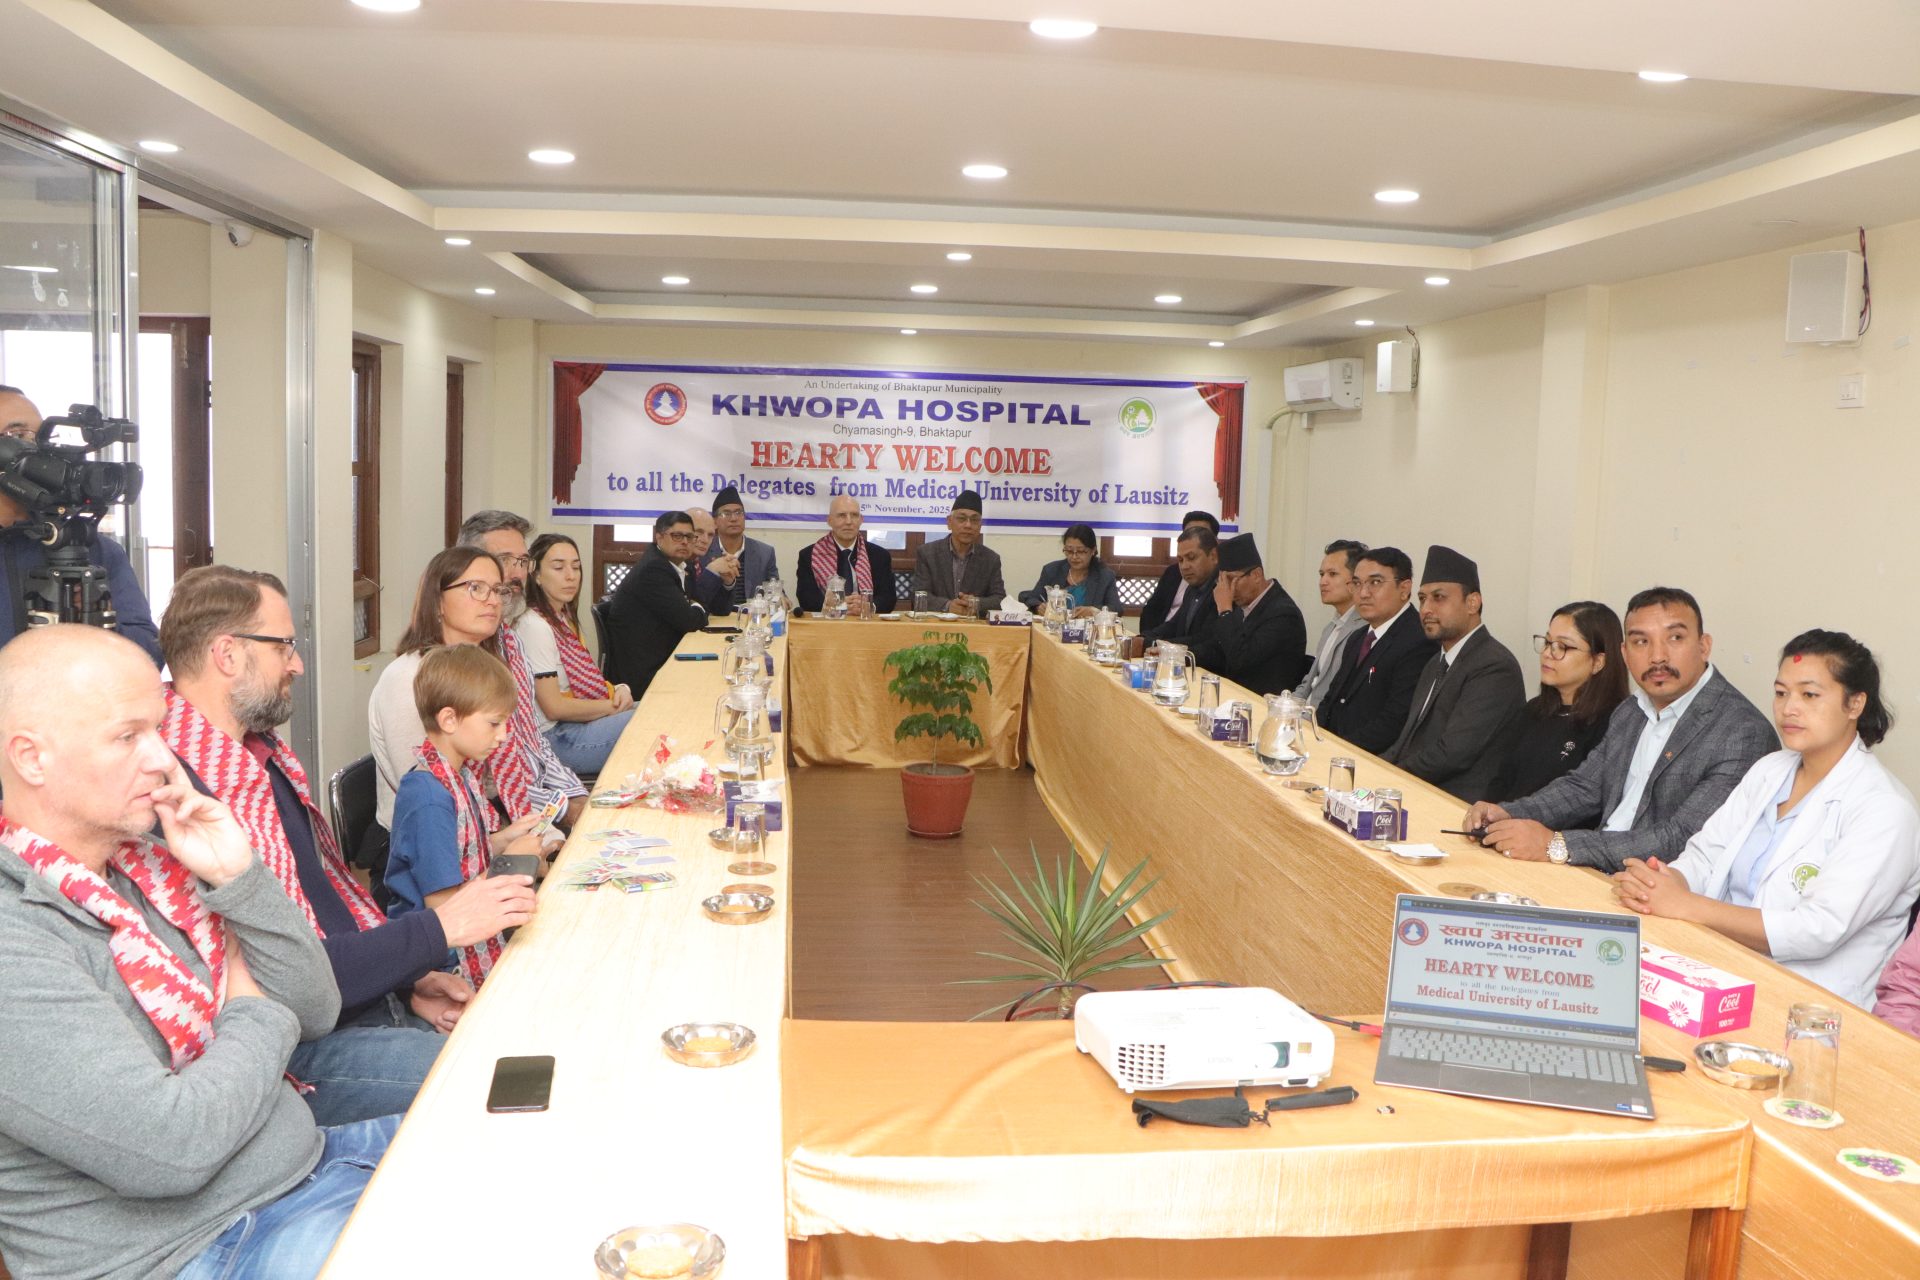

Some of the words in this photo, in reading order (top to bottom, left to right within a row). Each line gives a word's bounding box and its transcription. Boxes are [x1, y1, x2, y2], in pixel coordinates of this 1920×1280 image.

[804, 381, 818, 389] An
[820, 381, 879, 392] Undertaking
[881, 382, 892, 391] of
[894, 382, 942, 393] Bhaktapur
[945, 384, 1003, 396] Municipality
[712, 394, 884, 419] KHWOPA
[898, 399, 1091, 426] HOSPITAL
[833, 423, 916, 438] Chyamasingh-9,
[919, 426, 972, 438] Bhaktapur
[750, 441, 884, 470] HEARTY
[892, 445, 1052, 475] WELCOME
[607, 472, 629, 491] to
[636, 471, 663, 492] all
[671, 472, 704, 492] the
[711, 473, 816, 499] Delegates
[829, 476, 877, 497] from
[885, 478, 966, 499] Medical
[974, 480, 1081, 507] University
[1088, 483, 1109, 504] of
[1115, 484, 1189, 505] Lausitz
[874, 504, 926, 514] November,
[928, 505, 951, 514] 2025
[1439, 924, 1483, 938] ख्वप
[1490, 929, 1584, 948] अस्पताल
[1444, 938, 1503, 950] KHWOPA
[1508, 943, 1577, 958] HOSPITAL
[1424, 958, 1498, 978] HEARTY
[1503, 965, 1595, 988] WELCOME
[1416, 985, 1464, 1000] Medical
[1469, 990, 1533, 1010] University
[1536, 998, 1548, 1009] of
[1553, 998, 1600, 1015] Lausitz
[1542, 988, 1560, 997] from
[1718, 993, 1741, 1013] Cool
